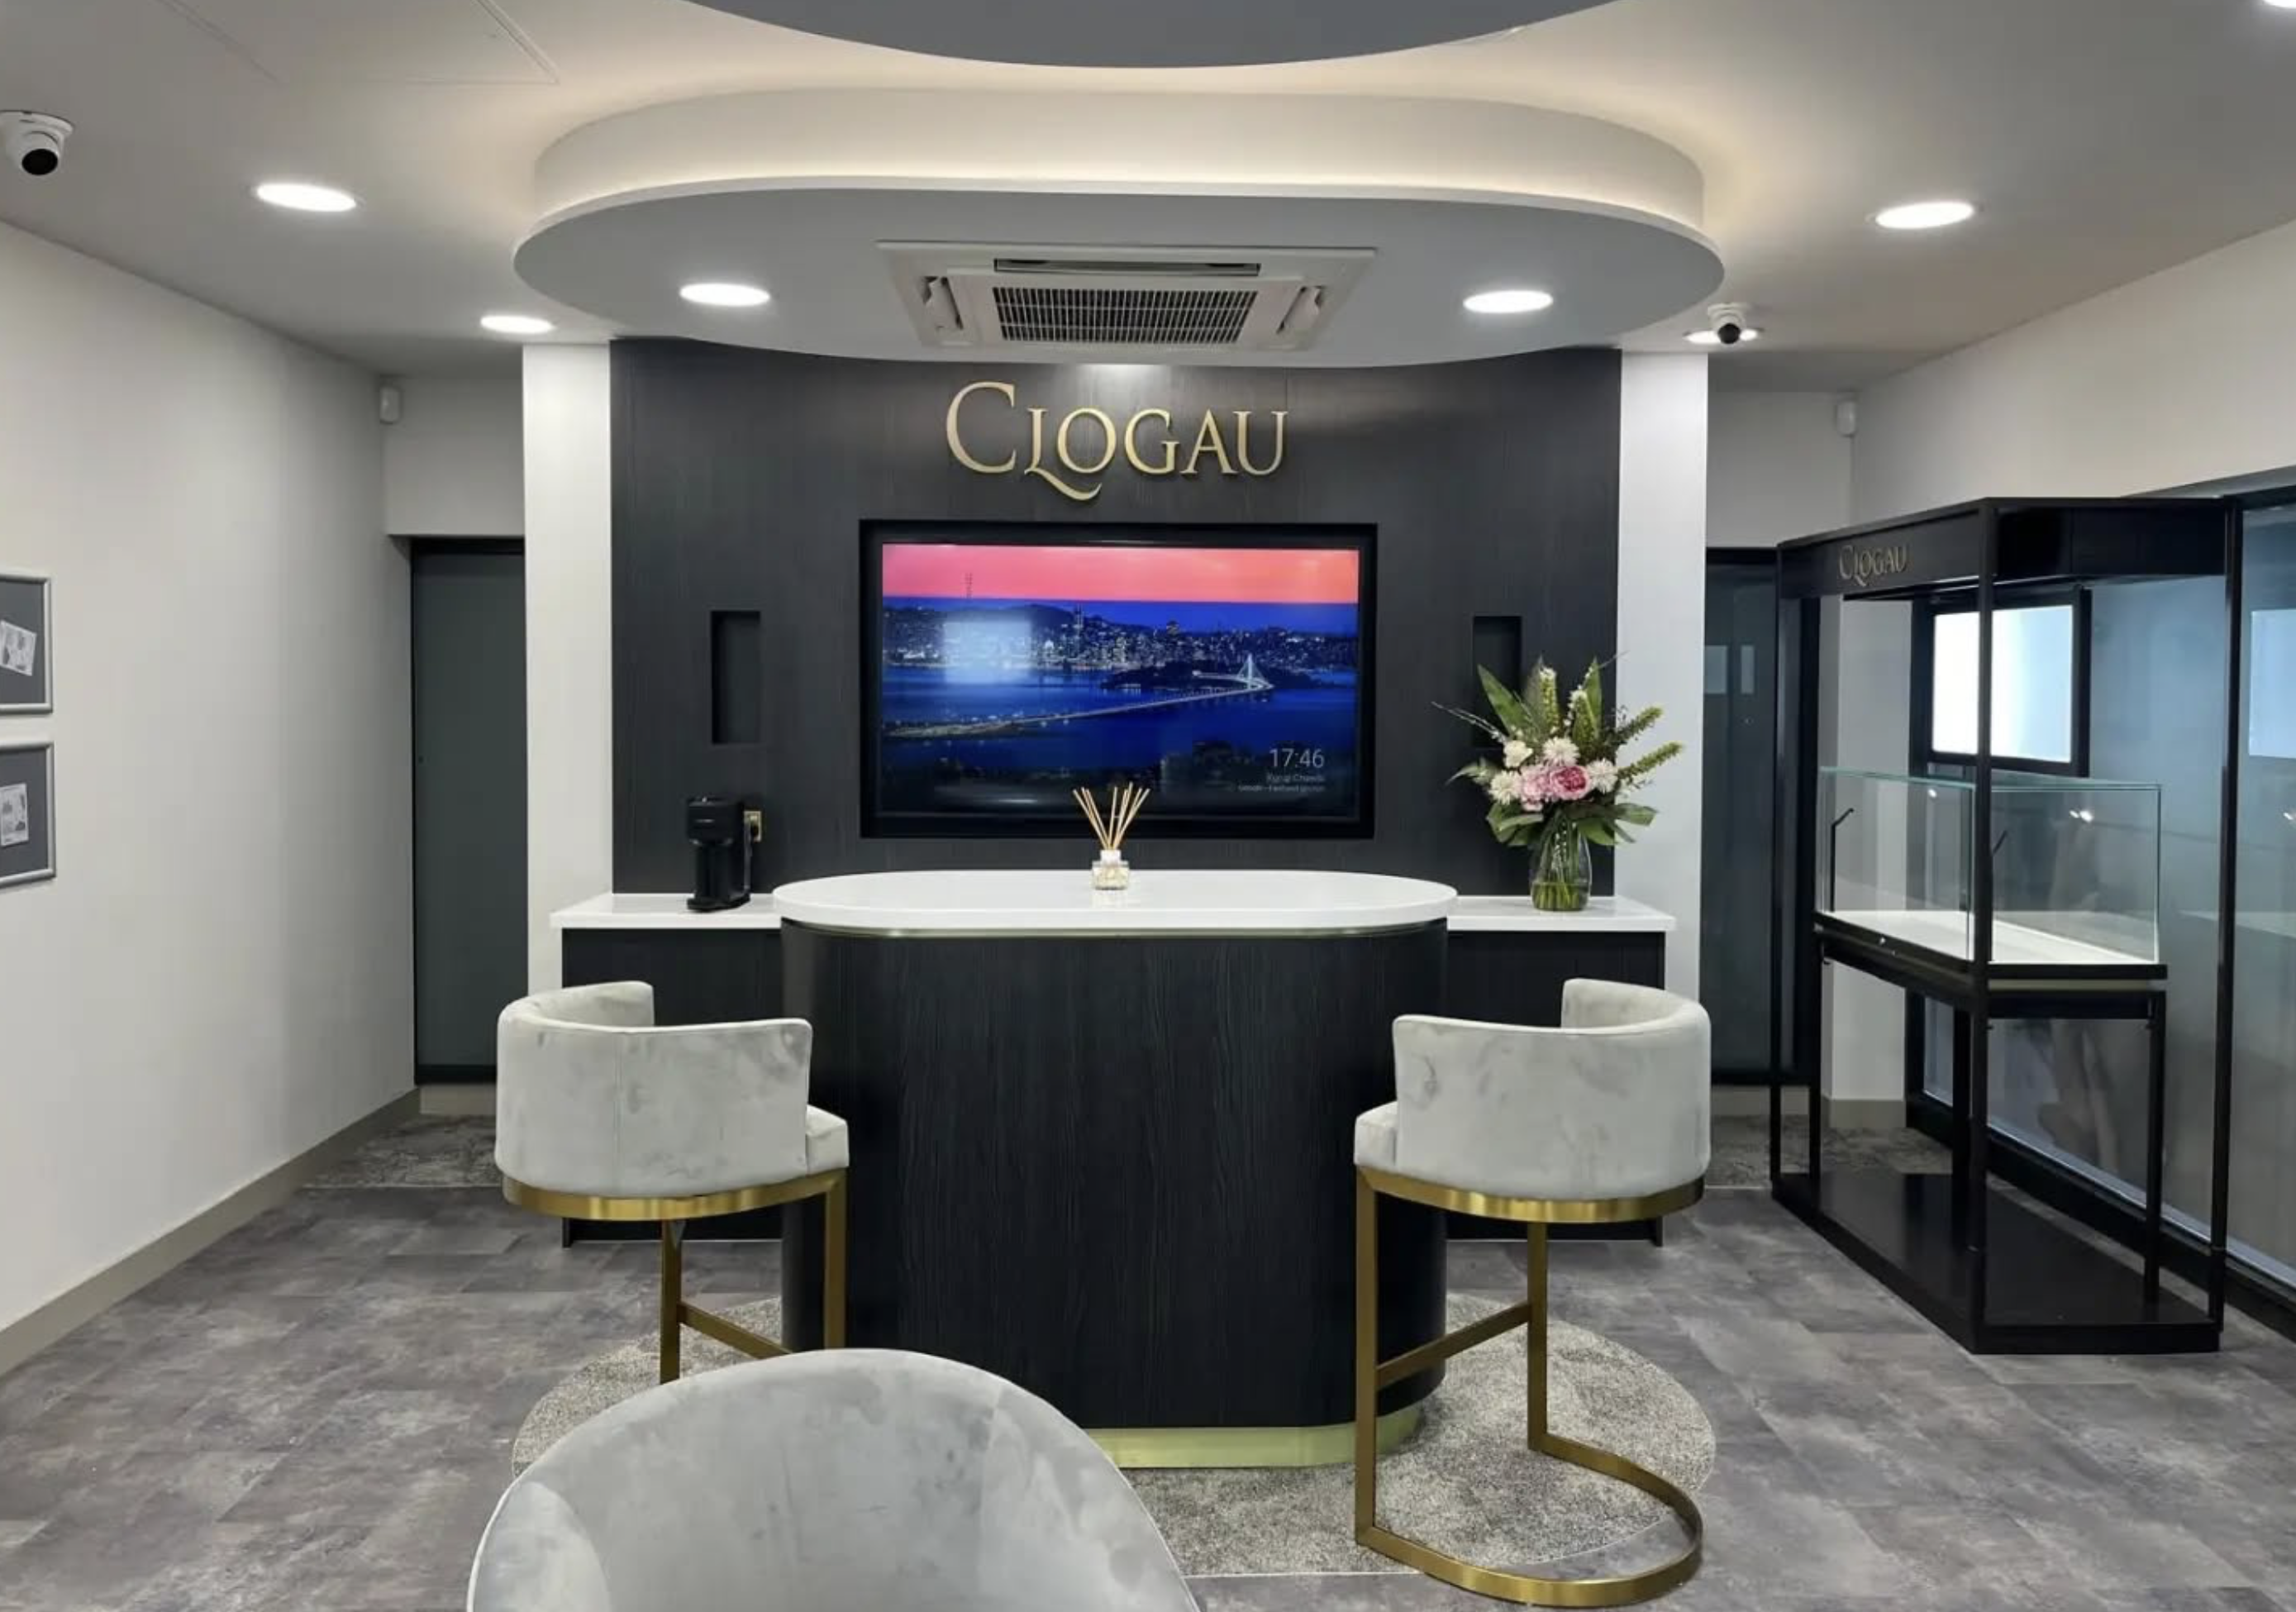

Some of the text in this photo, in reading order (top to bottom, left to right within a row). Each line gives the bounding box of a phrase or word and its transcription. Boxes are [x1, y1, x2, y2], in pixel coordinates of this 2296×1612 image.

[946, 381, 1288, 500] CLOGAU
[1840, 544, 1907, 587] CLOGAU
[1269, 748, 1325, 768] 17:46
